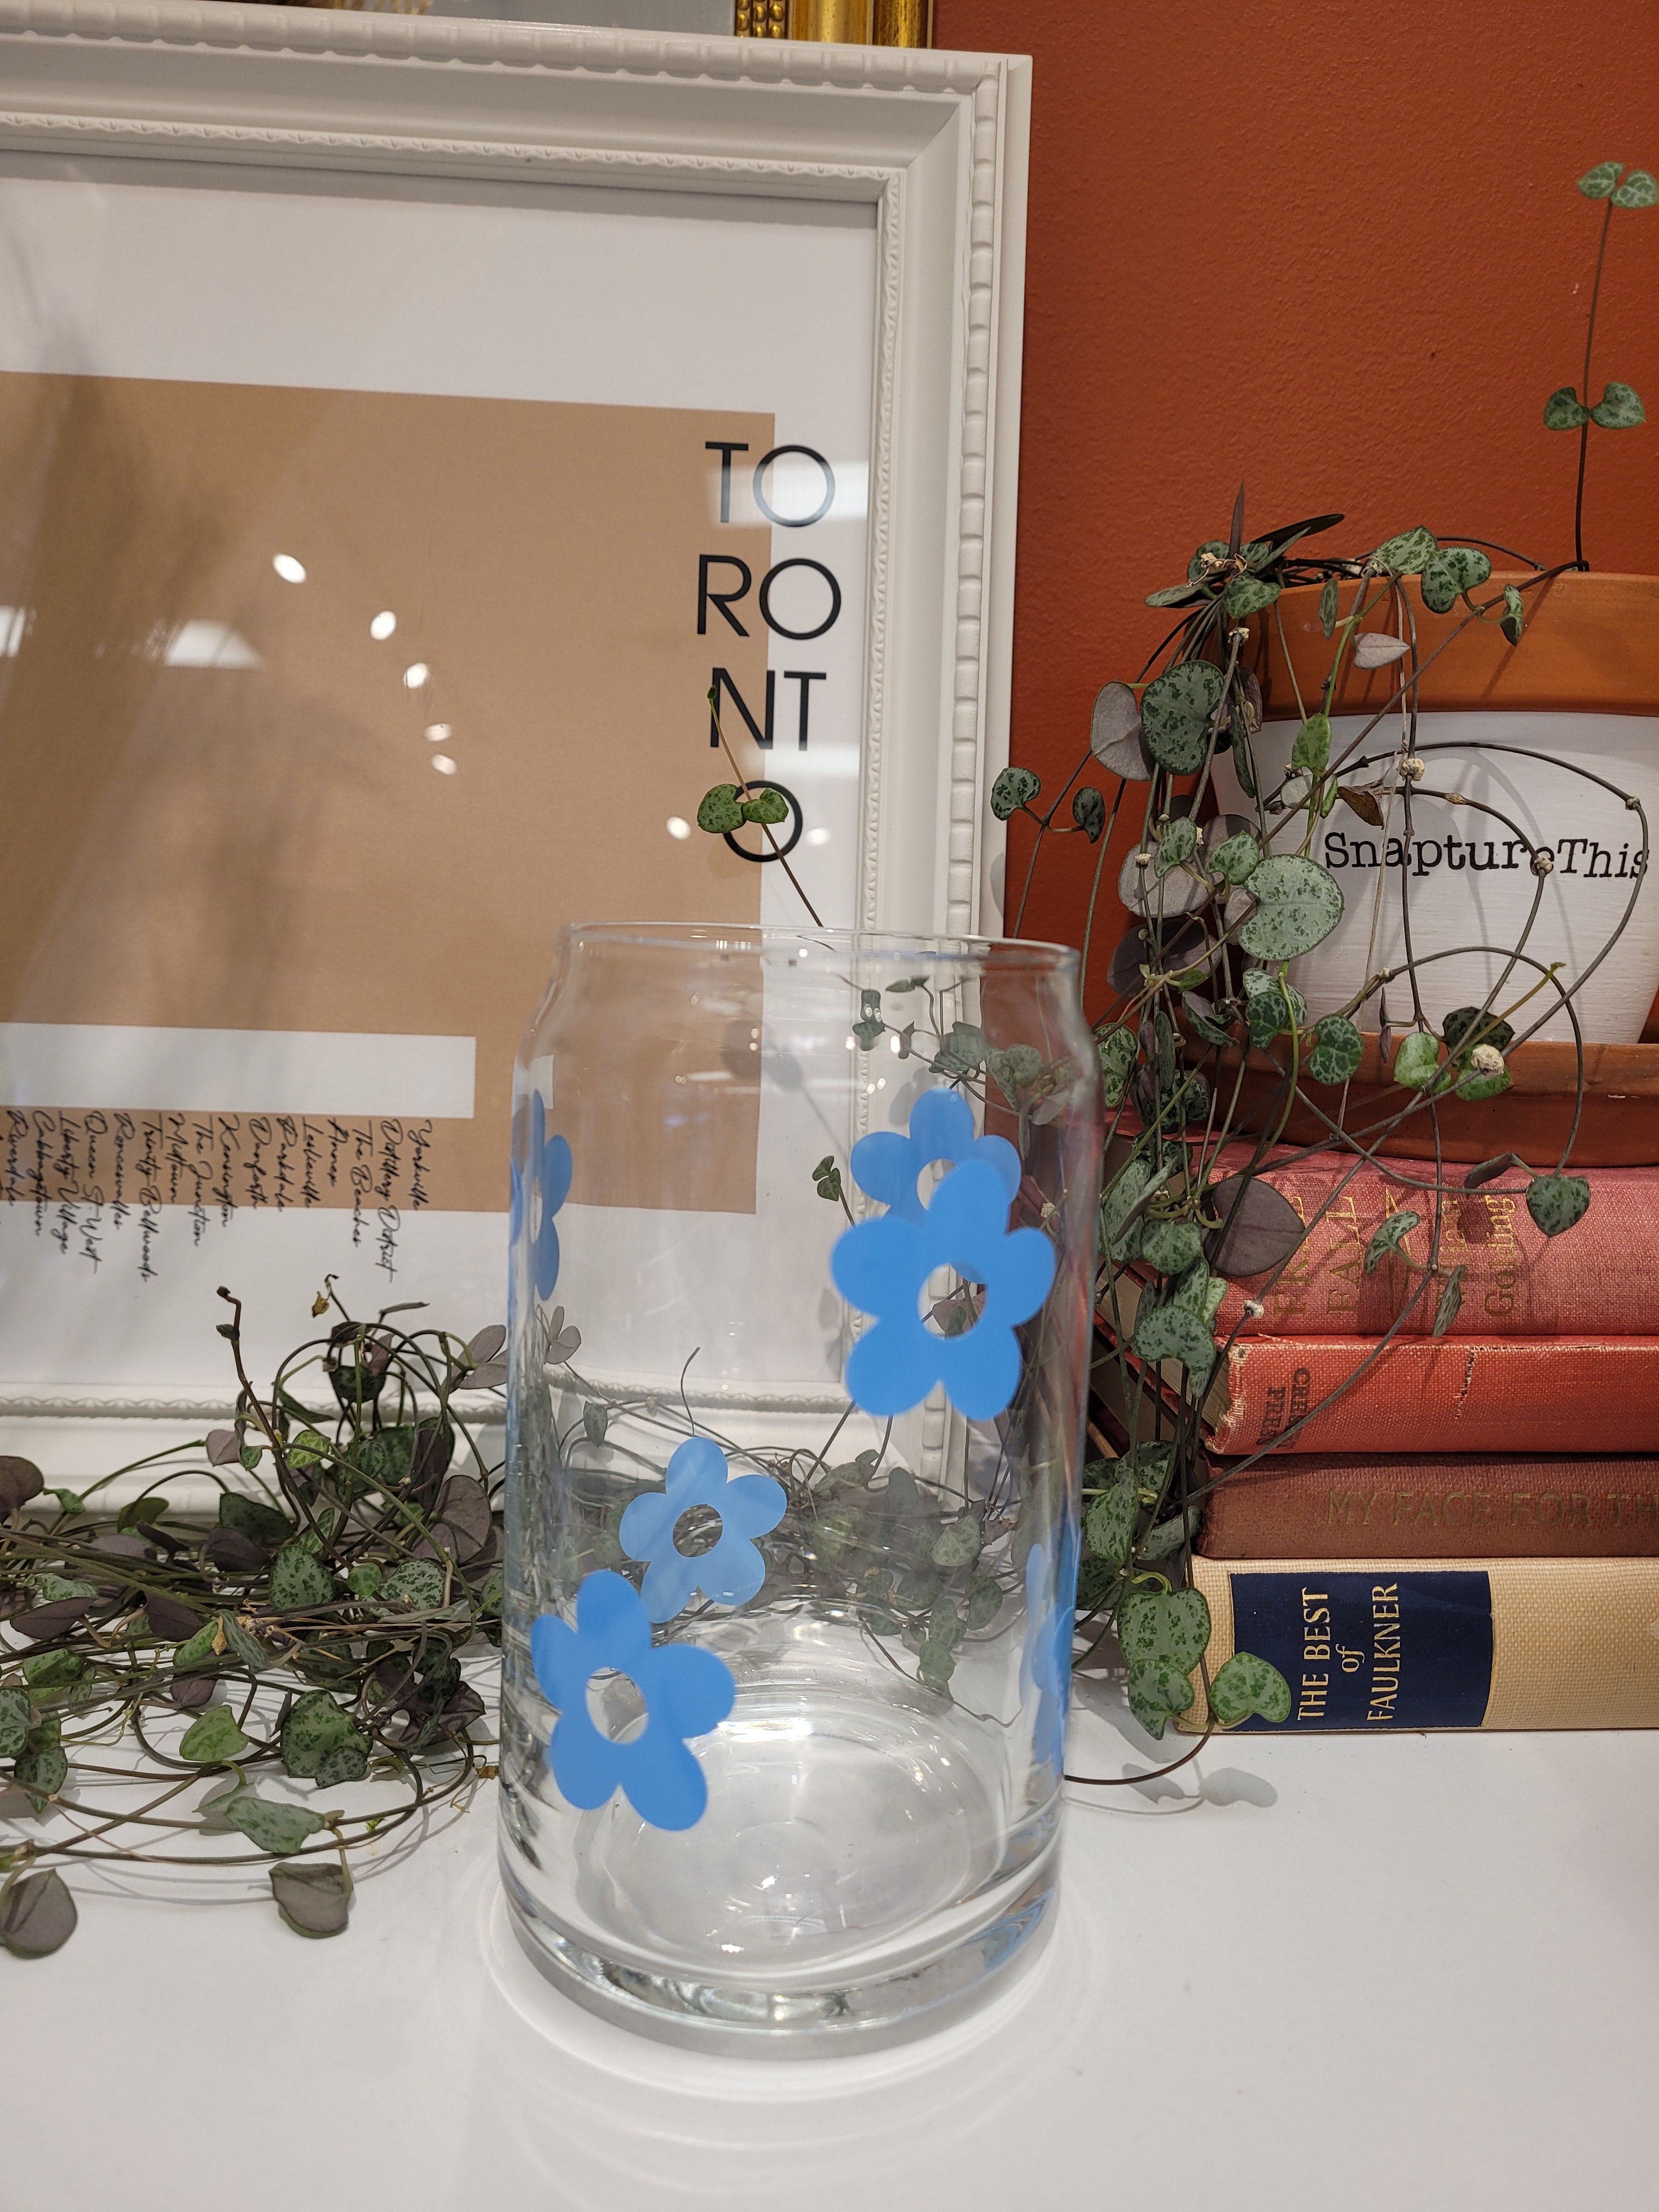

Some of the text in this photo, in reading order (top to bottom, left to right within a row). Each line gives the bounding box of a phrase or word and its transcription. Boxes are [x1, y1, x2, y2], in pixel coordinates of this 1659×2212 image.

[706, 442, 835, 527] TO
[697, 554, 841, 640] RO
[710, 667, 827, 751] NT
[723, 781, 803, 862] O
[5, 1110, 29, 1206] Riverdale
[27, 1110, 56, 1236] Cabbagetown
[51, 1110, 81, 1255] Liberty Village
[84, 1110, 109, 1180] Queen
[110, 1112, 136, 1230] Roncesvalles
[165, 1113, 189, 1204] Midtown
[186, 1114, 214, 1247] The Junction
[212, 1115, 241, 1228] Kensington
[243, 1117, 273, 1210] Danforth
[274, 1115, 298, 1212] Parkdale
[301, 1116, 324, 1208] Leslieville
[327, 1117, 349, 1188] Annex
[350, 1120, 374, 1247] The Beaches
[407, 1119, 433, 1210] Yorkville
[80, 1217, 104, 1273] West
[374, 1119, 404, 1283] Distillery District
[1326, 1196, 1361, 1315] FALL
[1485, 1195, 1517, 1317] Golding
[1327, 1490, 1378, 1525] MY
[1393, 1491, 1491, 1526] FACE
[1510, 1492, 1592, 1526] FOR
[1297, 1587, 1331, 1720] THE BEST
[1335, 1643, 1365, 1673] of
[1367, 1582, 1401, 1721] FAULKNER
